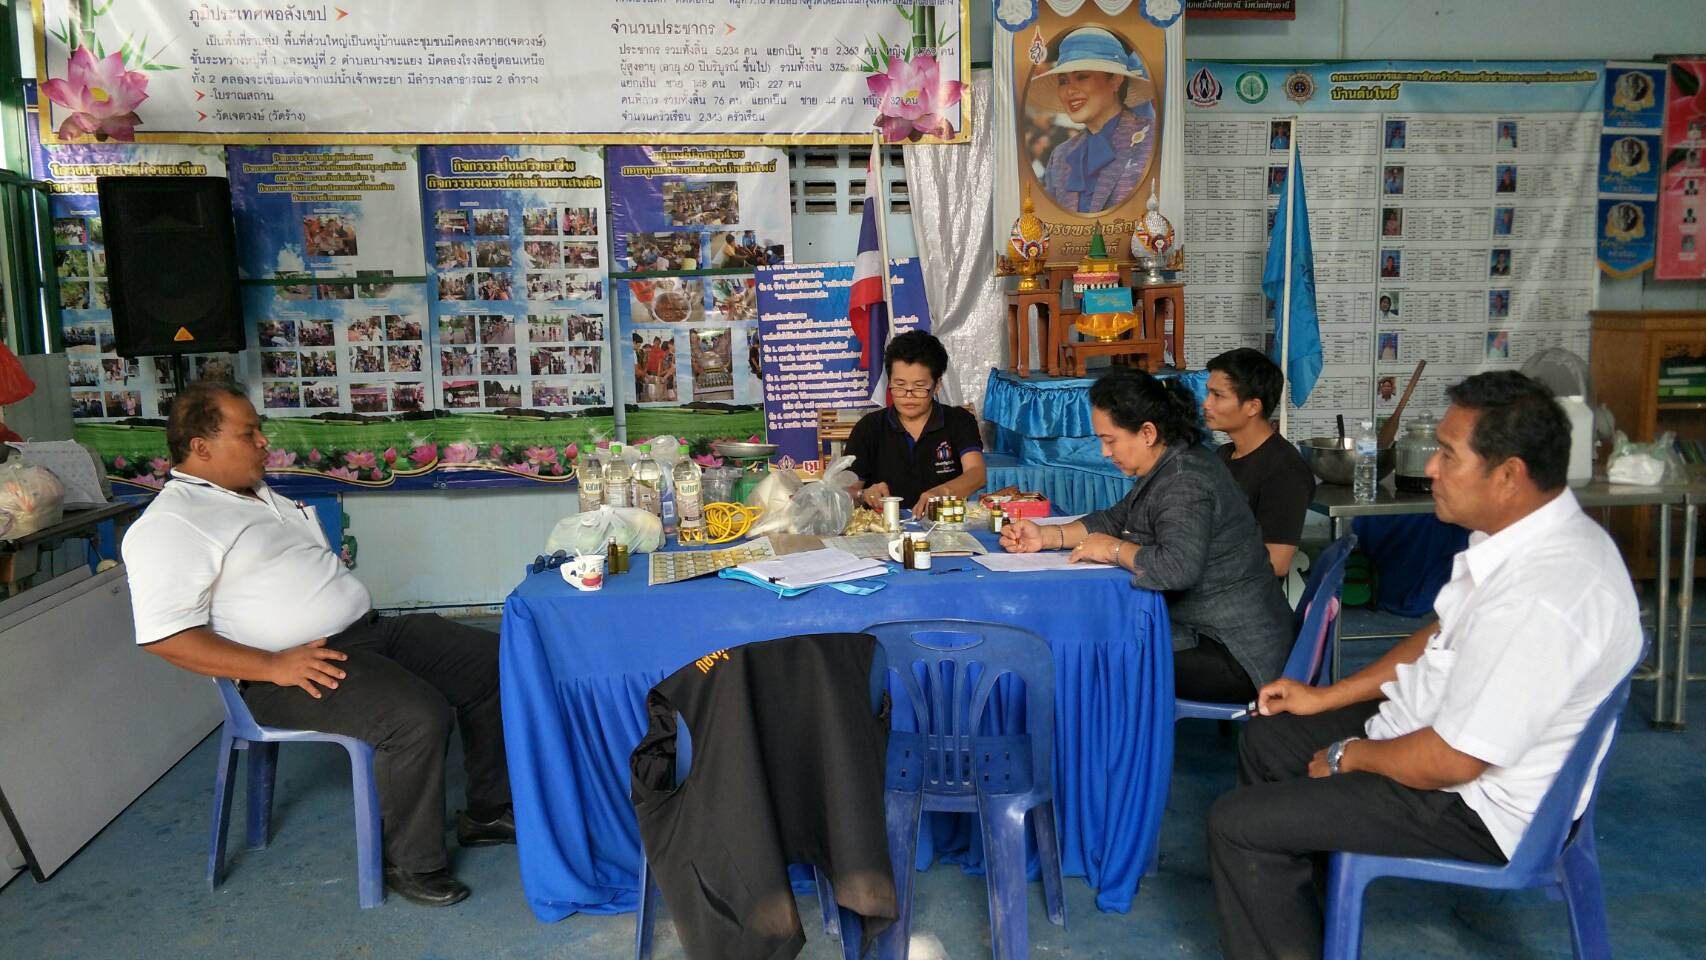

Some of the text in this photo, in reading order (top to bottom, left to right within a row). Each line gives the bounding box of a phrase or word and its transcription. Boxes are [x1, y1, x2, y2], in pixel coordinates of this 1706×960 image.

[611, 19, 716, 35] จำนวนประชากร
[619, 44, 660, 56] ประชากร
[665, 40, 708, 56] รวมทั้งสิ้น
[715, 47, 740, 57] 5,234
[744, 47, 757, 56] คน
[766, 44, 802, 56] แยกเป็น
[811, 47, 828, 56] ชาย
[864, 47, 878, 56] คน
[886, 44, 905, 59] หญิง
[940, 47, 955, 57] คน
[330, 56, 337, 65] 2
[620, 59, 656, 76] ผู้สูงอายุ
[684, 63, 695, 72] 60
[781, 57, 822, 73] รวมทั้งสิ้น
[209, 74, 216, 84] 2
[496, 74, 503, 84] 2
[620, 77, 656, 88] แยกเป็น
[712, 79, 726, 88] คน
[739, 77, 760, 91] หญิง
[767, 79, 783, 89] 227
[788, 79, 802, 88] คน
[713, 96, 725, 105] 76
[752, 94, 787, 105] แยกเป็น
[800, 96, 818, 105] ชาย
[841, 96, 854, 105] คน
[890, 96, 901, 105] 32
[905, 96, 918, 105] คน
[622, 110, 691, 122] จำนวนครัวเรือน
[452, 157, 576, 173] กิจกรรมส่งเสริมอาชีพ
